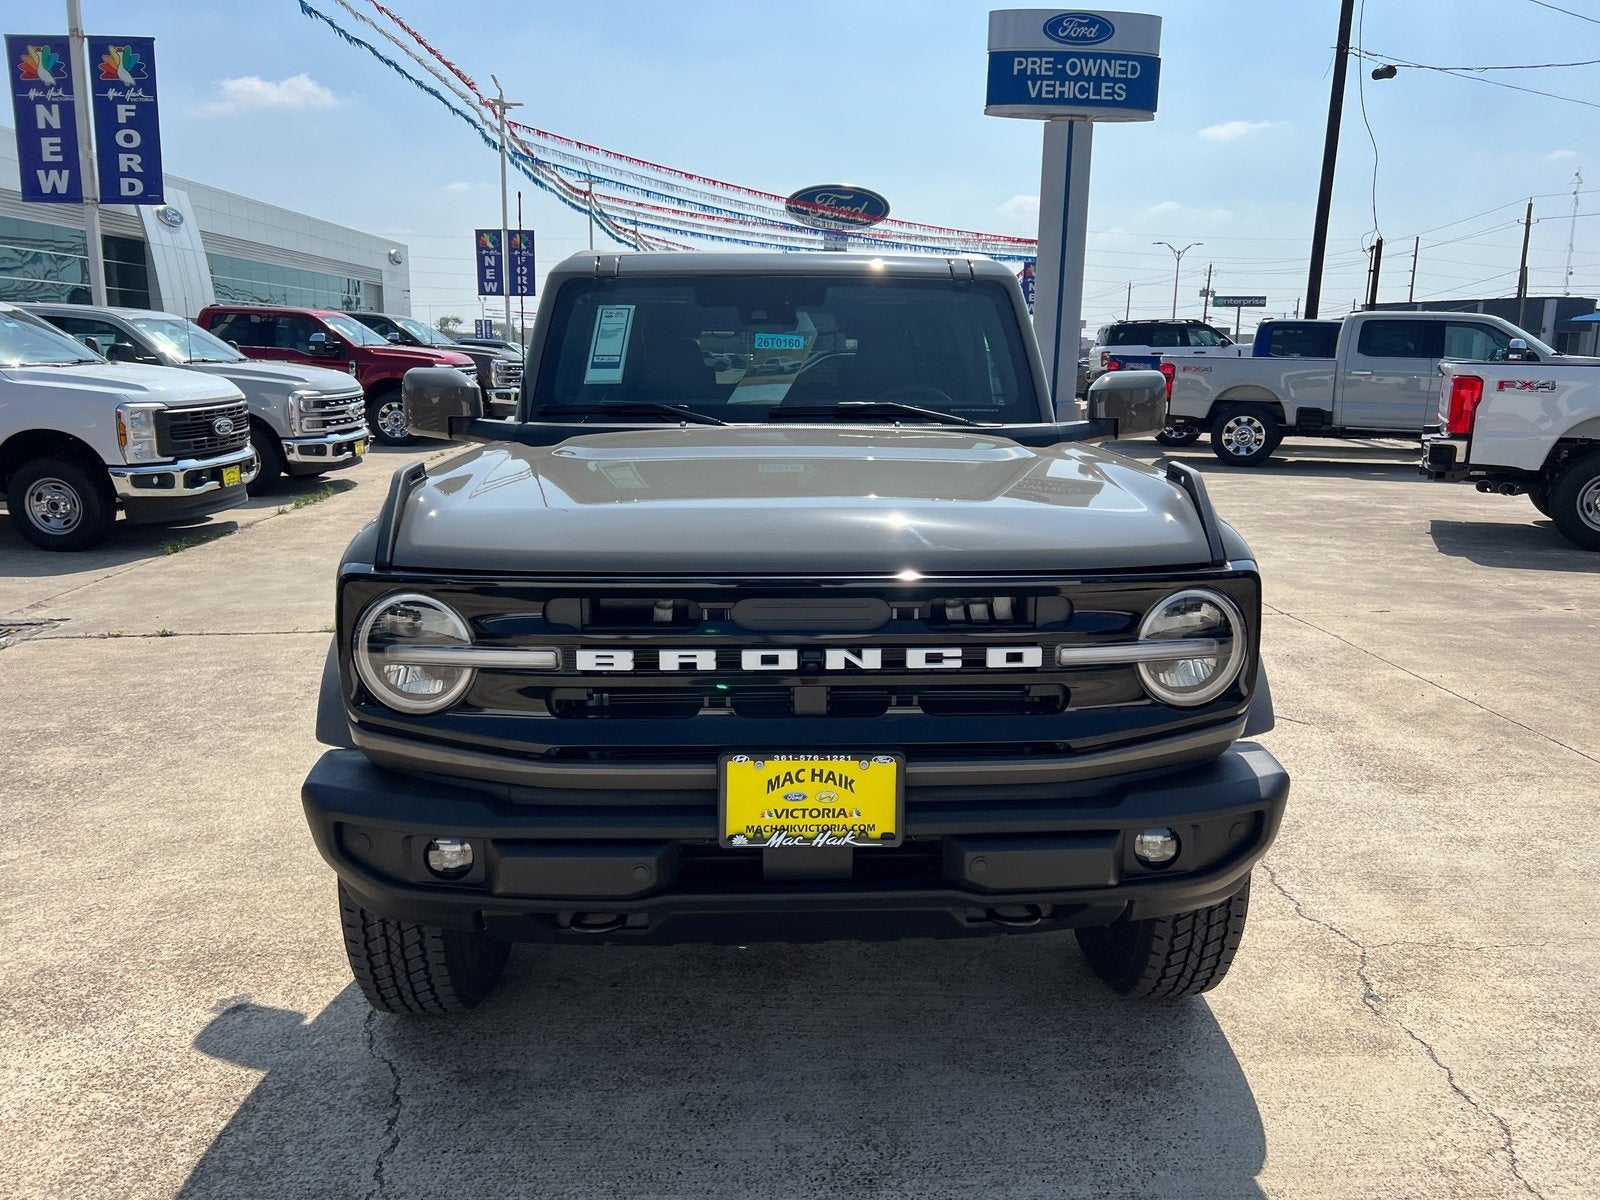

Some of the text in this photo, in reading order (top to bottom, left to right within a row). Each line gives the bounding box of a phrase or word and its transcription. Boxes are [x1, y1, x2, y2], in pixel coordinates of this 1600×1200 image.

[1058, 17, 1099, 38] Ford
[1027, 81, 1127, 101] VEHICLES
[36, 104, 69, 194] NEW
[115, 104, 144, 196] FORD
[484, 256, 498, 292] NEW
[517, 257, 528, 293] FORD
[1217, 298, 1265, 306] enterprise
[757, 338, 801, 349] 26T0160
[1497, 380, 1556, 391] FX4
[576, 648, 1043, 671] BRONCO
[767, 768, 855, 794] MAC HAIK
[774, 808, 848, 819] VICTORIA
[766, 830, 857, 848] Mac Haik
